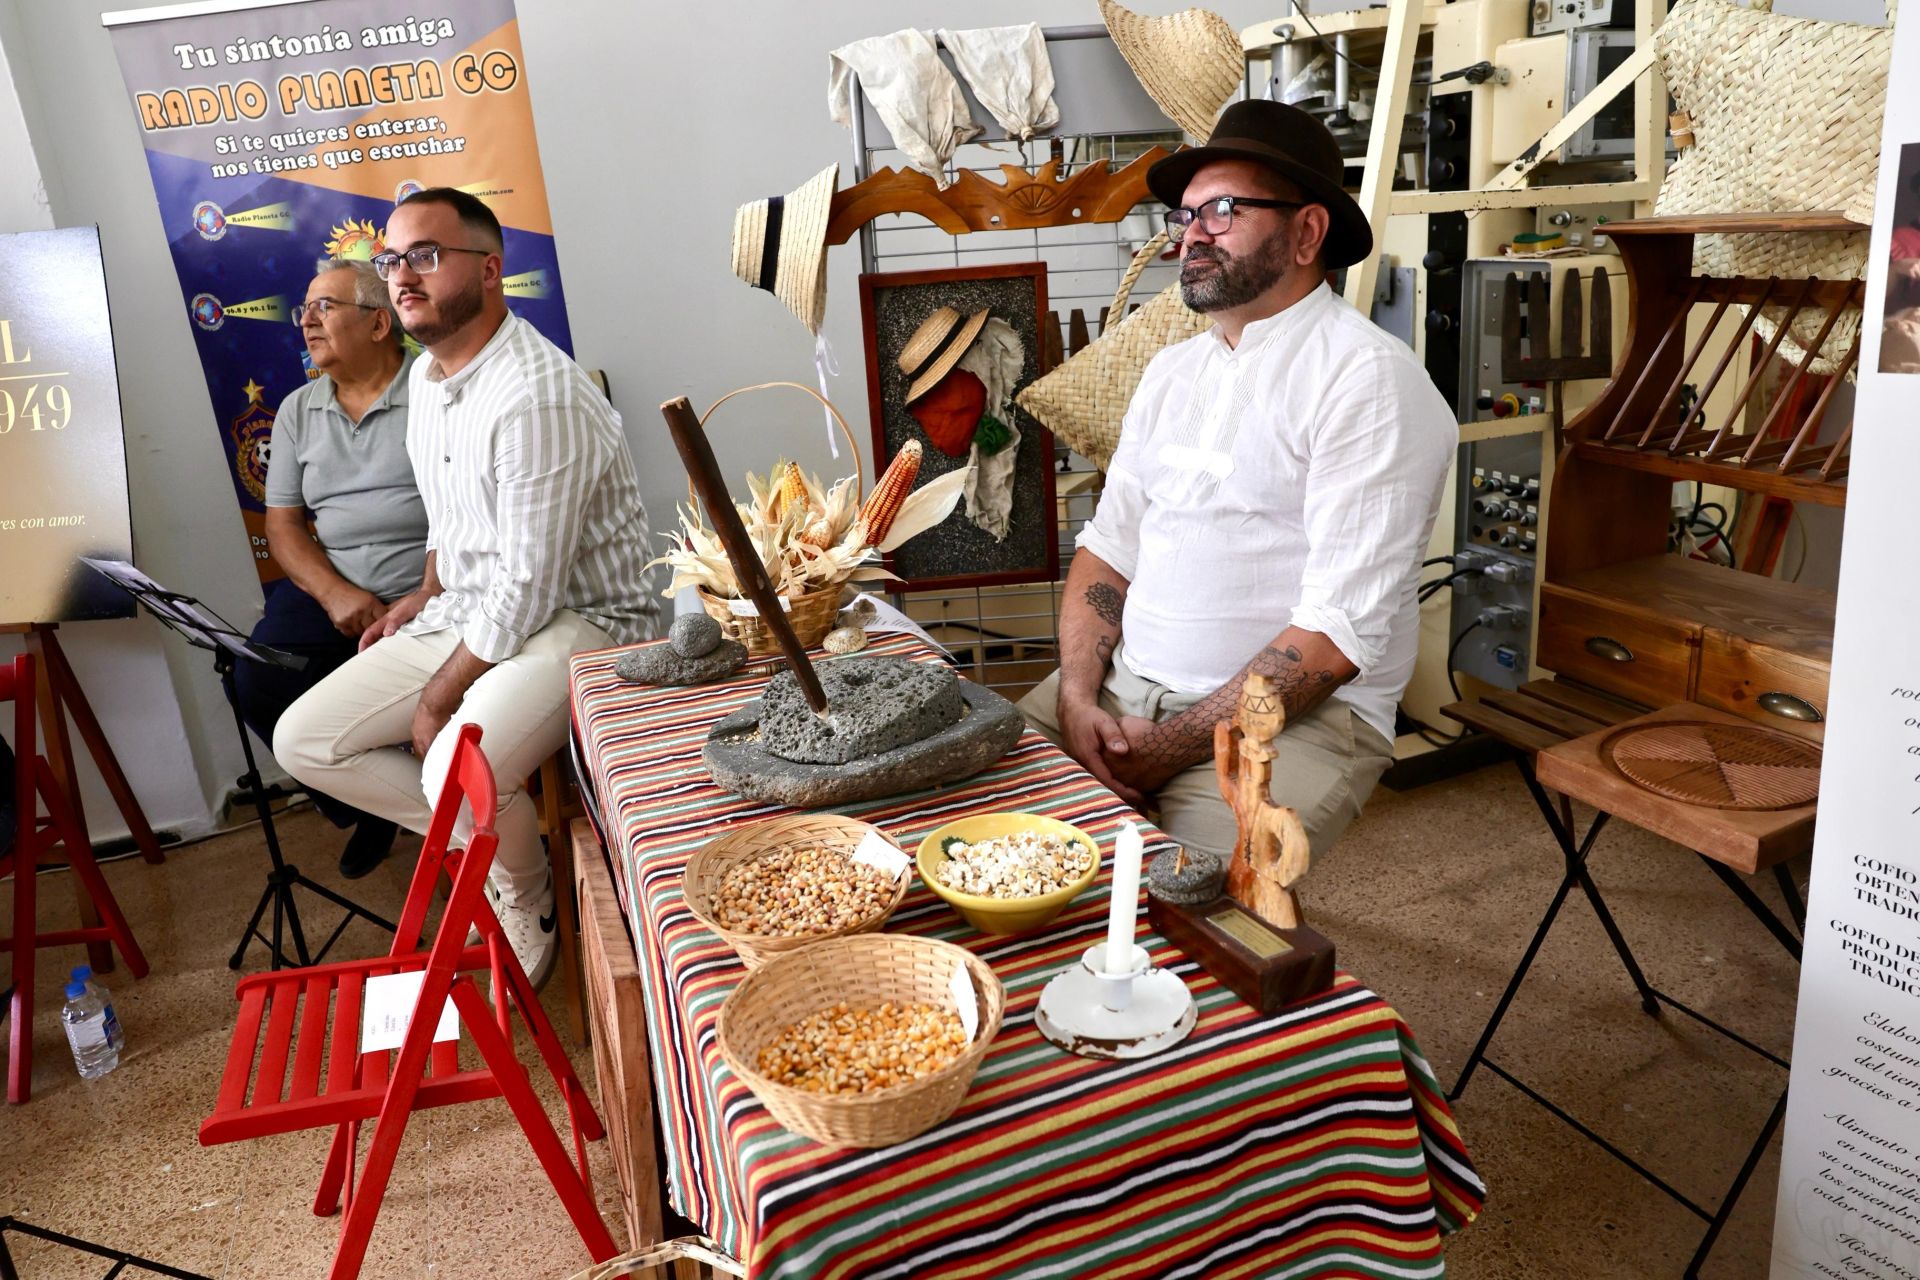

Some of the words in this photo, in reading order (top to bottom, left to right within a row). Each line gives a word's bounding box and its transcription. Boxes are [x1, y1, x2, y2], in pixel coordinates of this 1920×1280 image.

[173, 43, 218, 70] Tu
[224, 25, 352, 64] sintonía
[361, 16, 455, 48] amiga
[136, 81, 268, 131] RADIO
[278, 60, 443, 114] PLANETA
[453, 51, 517, 94] GC
[215, 136, 238, 154] Si
[242, 135, 264, 152] te
[269, 126, 349, 152] quieres
[354, 116, 447, 140] enterar,
[211, 162, 249, 179] nos
[253, 153, 318, 174] tienes
[322, 148, 364, 169] que
[369, 135, 467, 161] escuchar
[253, 213, 279, 221] Planeta
[0, 319, 31, 364] L
[20, 518, 44, 529] con
[48, 515, 86, 527] amor.
[1854, 854, 1916, 885] GOFIO
[1855, 872, 1920, 905] OBTEN
[1830, 919, 1890, 951] GOFIO
[1842, 939, 1920, 981] PRODUC
[1850, 958, 1920, 998] TRADIC
[1822, 1067, 1896, 1101] gracias
[1897, 1099, 1914, 1109] a
[1853, 1056, 1884, 1073] del
[1884, 1070, 1920, 1097] tiem
[1823, 1113, 1909, 1155] Alimento
[1837, 1139, 1858, 1153] en
[1819, 1150, 1840, 1164] su
[1819, 1168, 1845, 1187] los
[1813, 1186, 1858, 1213] valor
